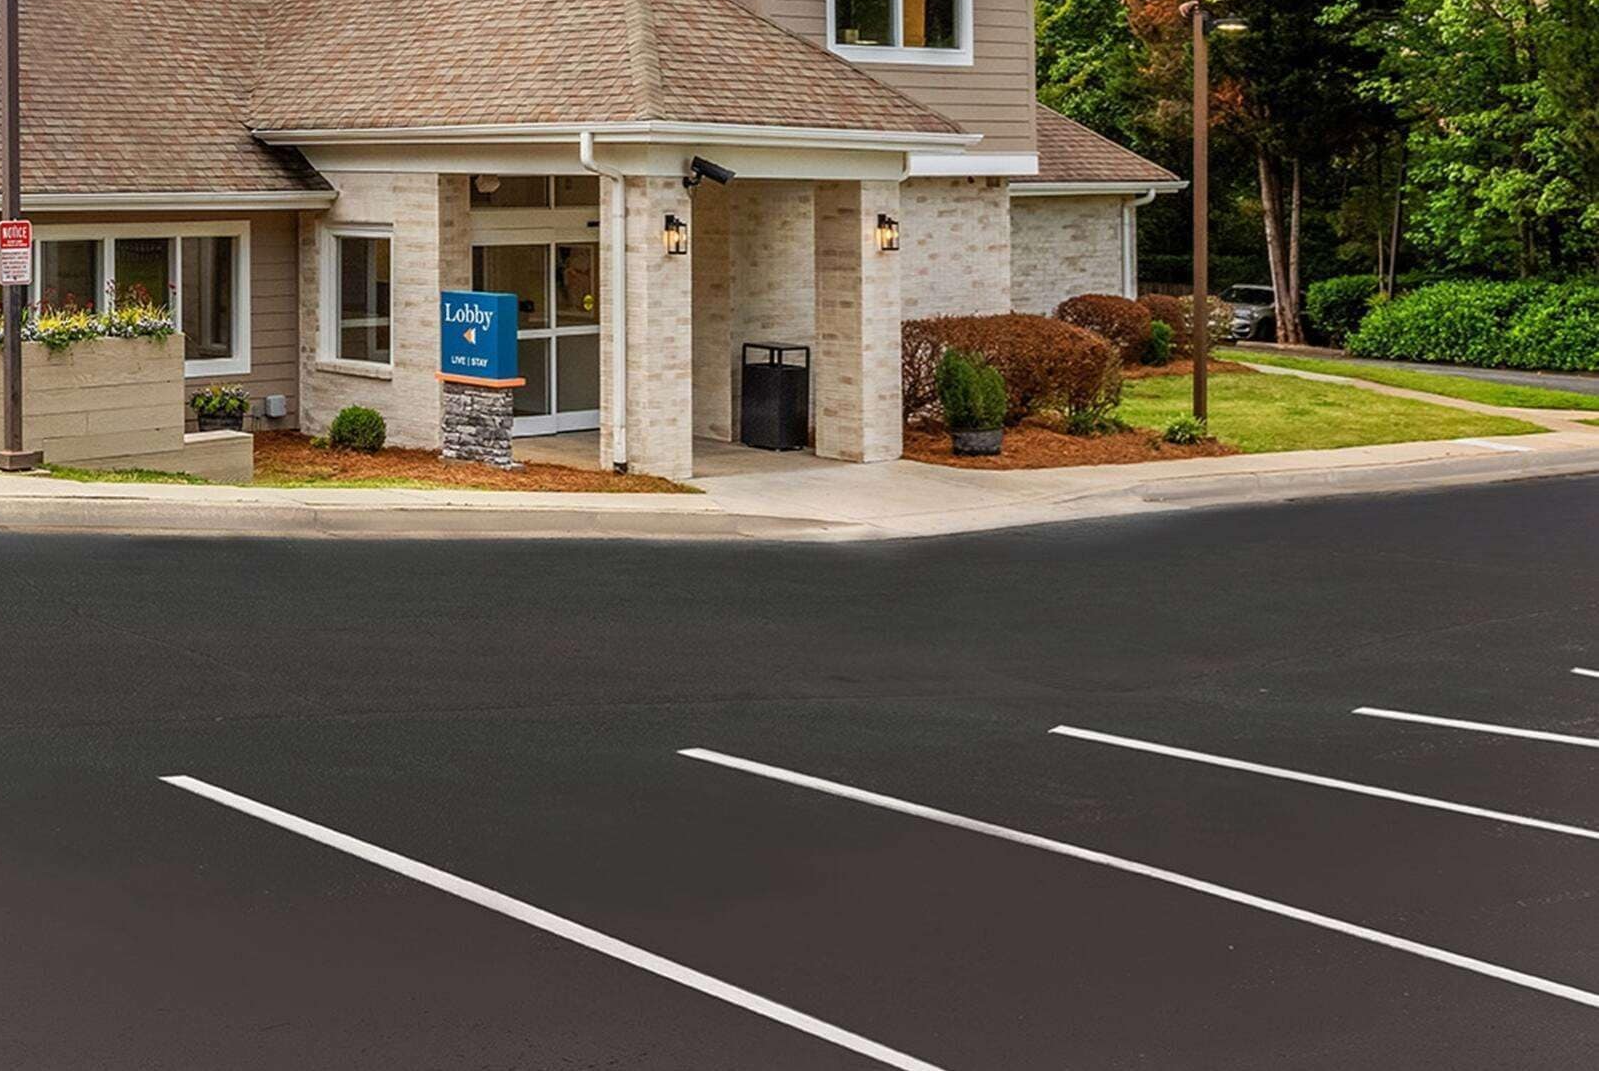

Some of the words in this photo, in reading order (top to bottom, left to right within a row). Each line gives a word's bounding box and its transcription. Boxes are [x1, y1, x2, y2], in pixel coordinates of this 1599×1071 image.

[445, 303, 493, 331] Lobby
[451, 355, 466, 366] LIVE
[472, 357, 489, 367] STAY
